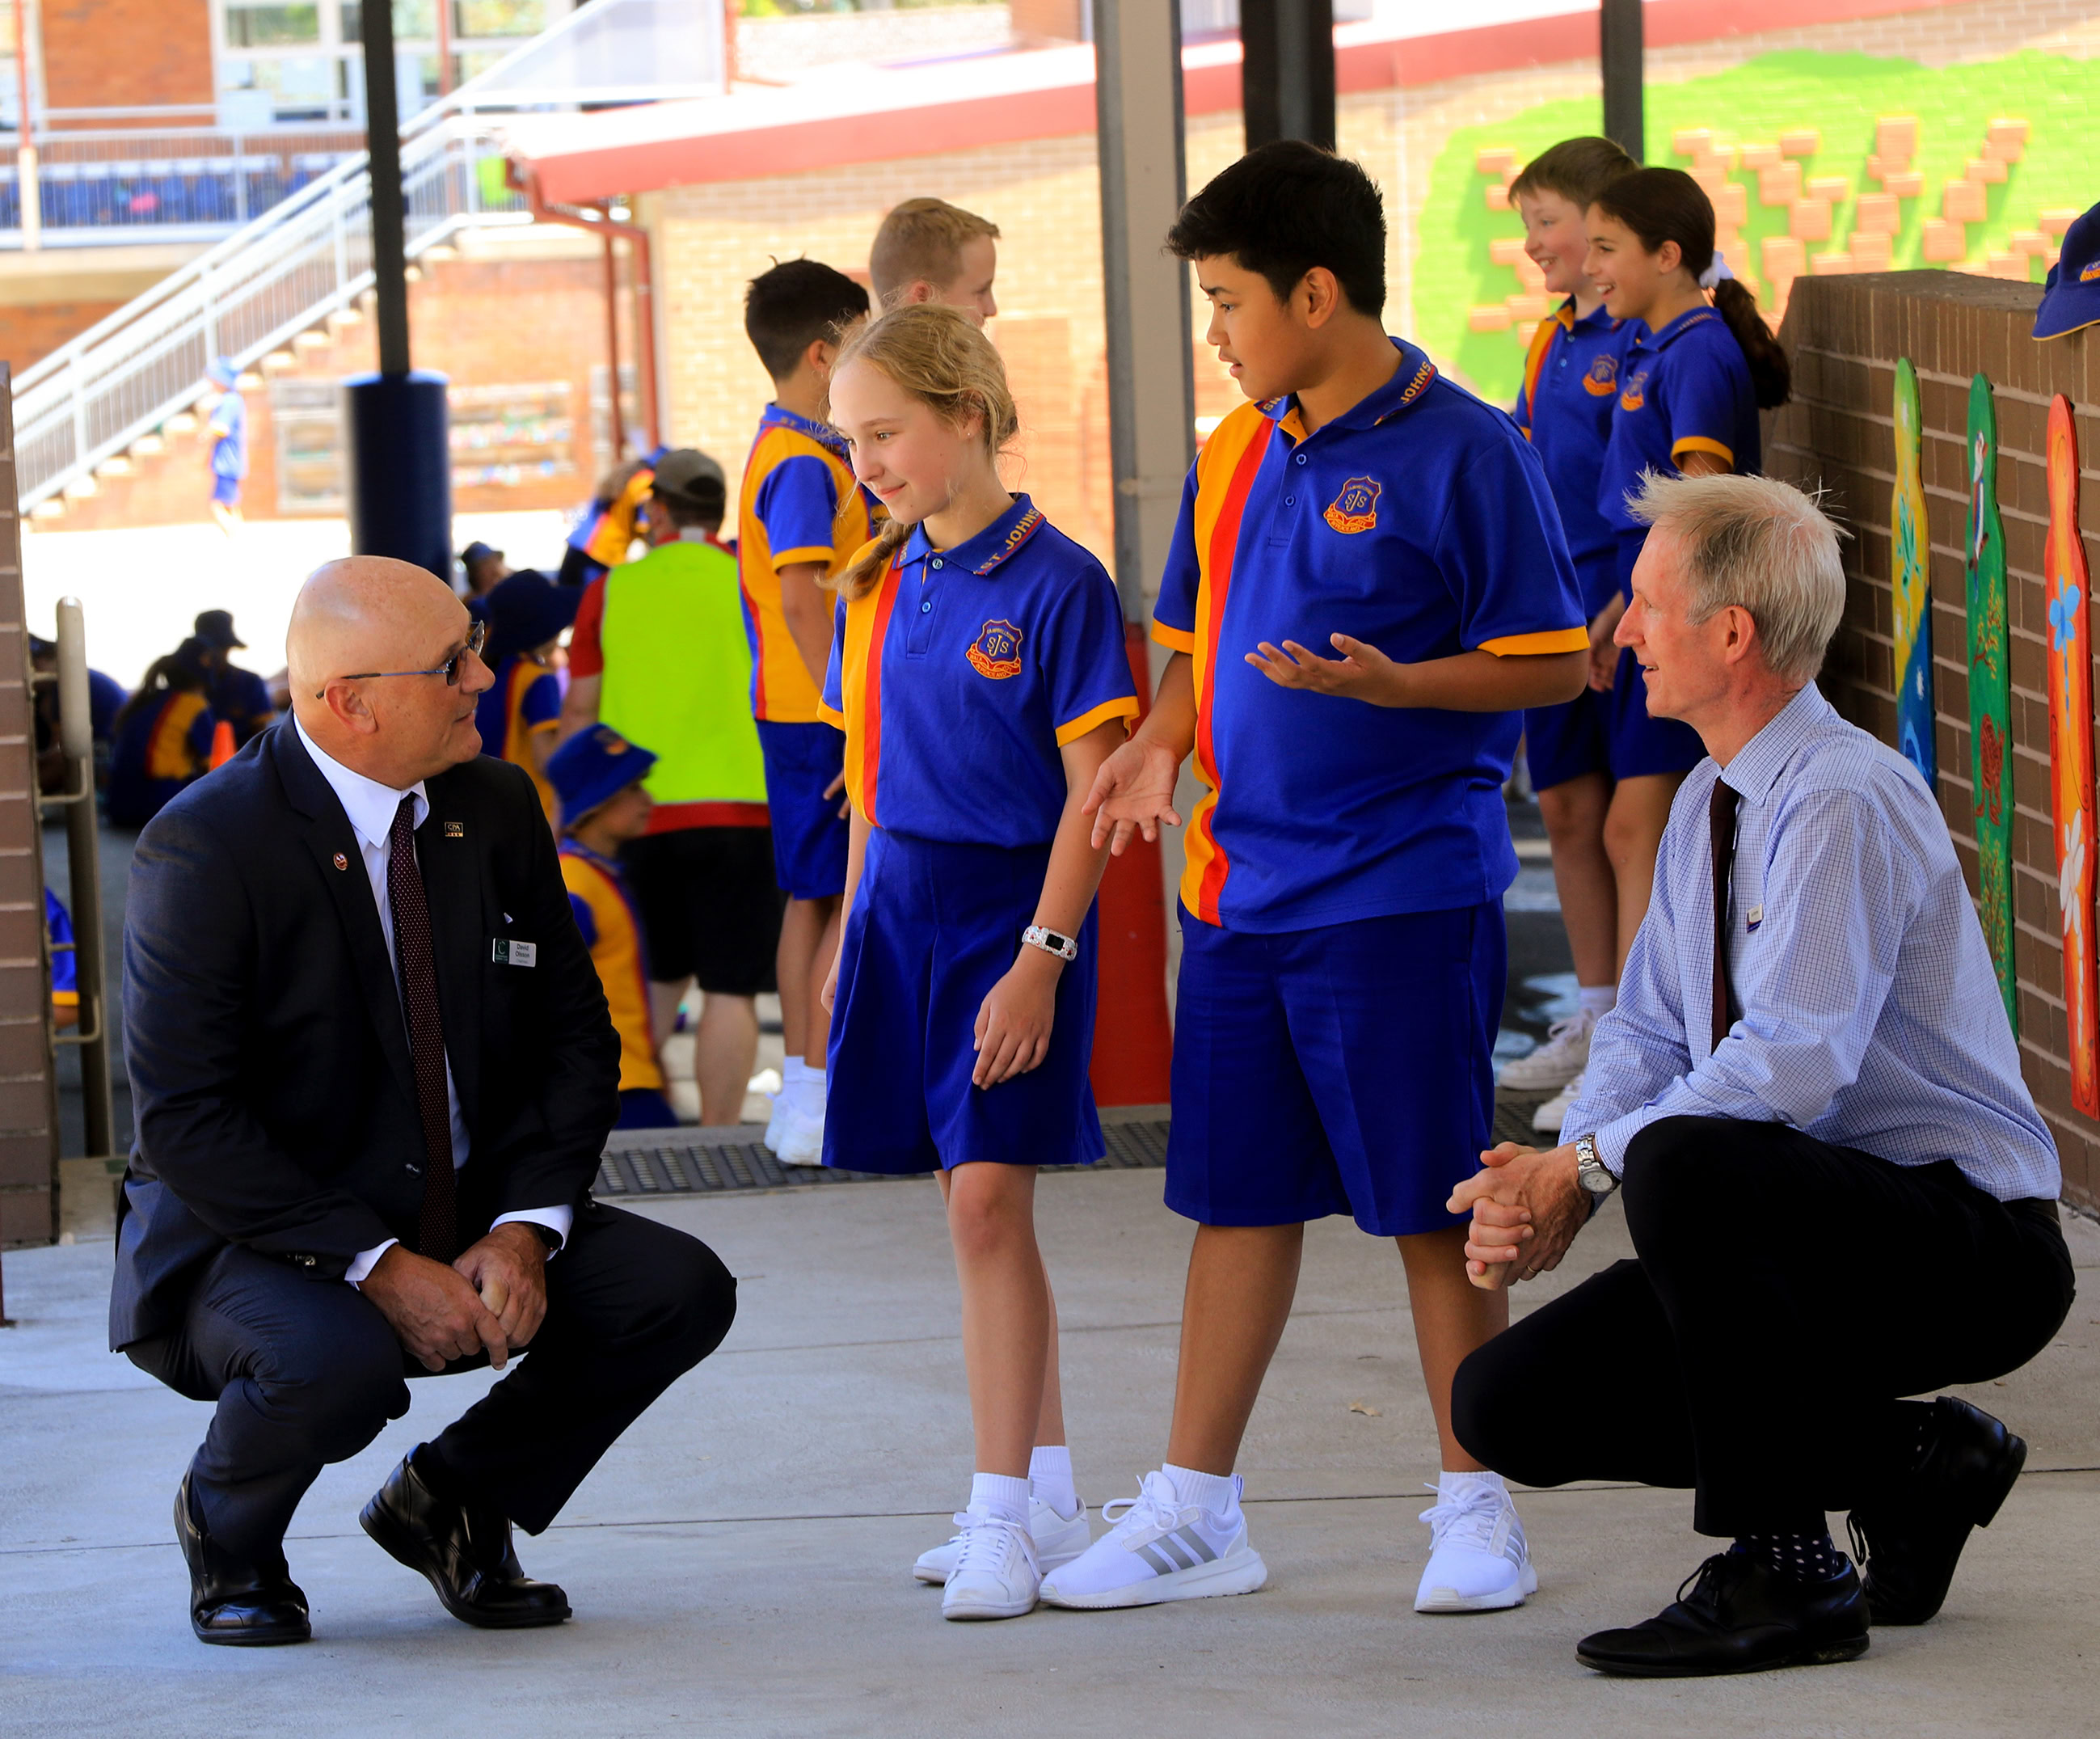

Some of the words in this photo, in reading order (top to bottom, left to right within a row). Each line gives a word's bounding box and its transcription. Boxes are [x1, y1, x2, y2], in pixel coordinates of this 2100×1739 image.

[1400, 361, 1432, 404] JOHNS
[980, 552, 1001, 569] ST
[1005, 508, 1040, 550] JOHNS
